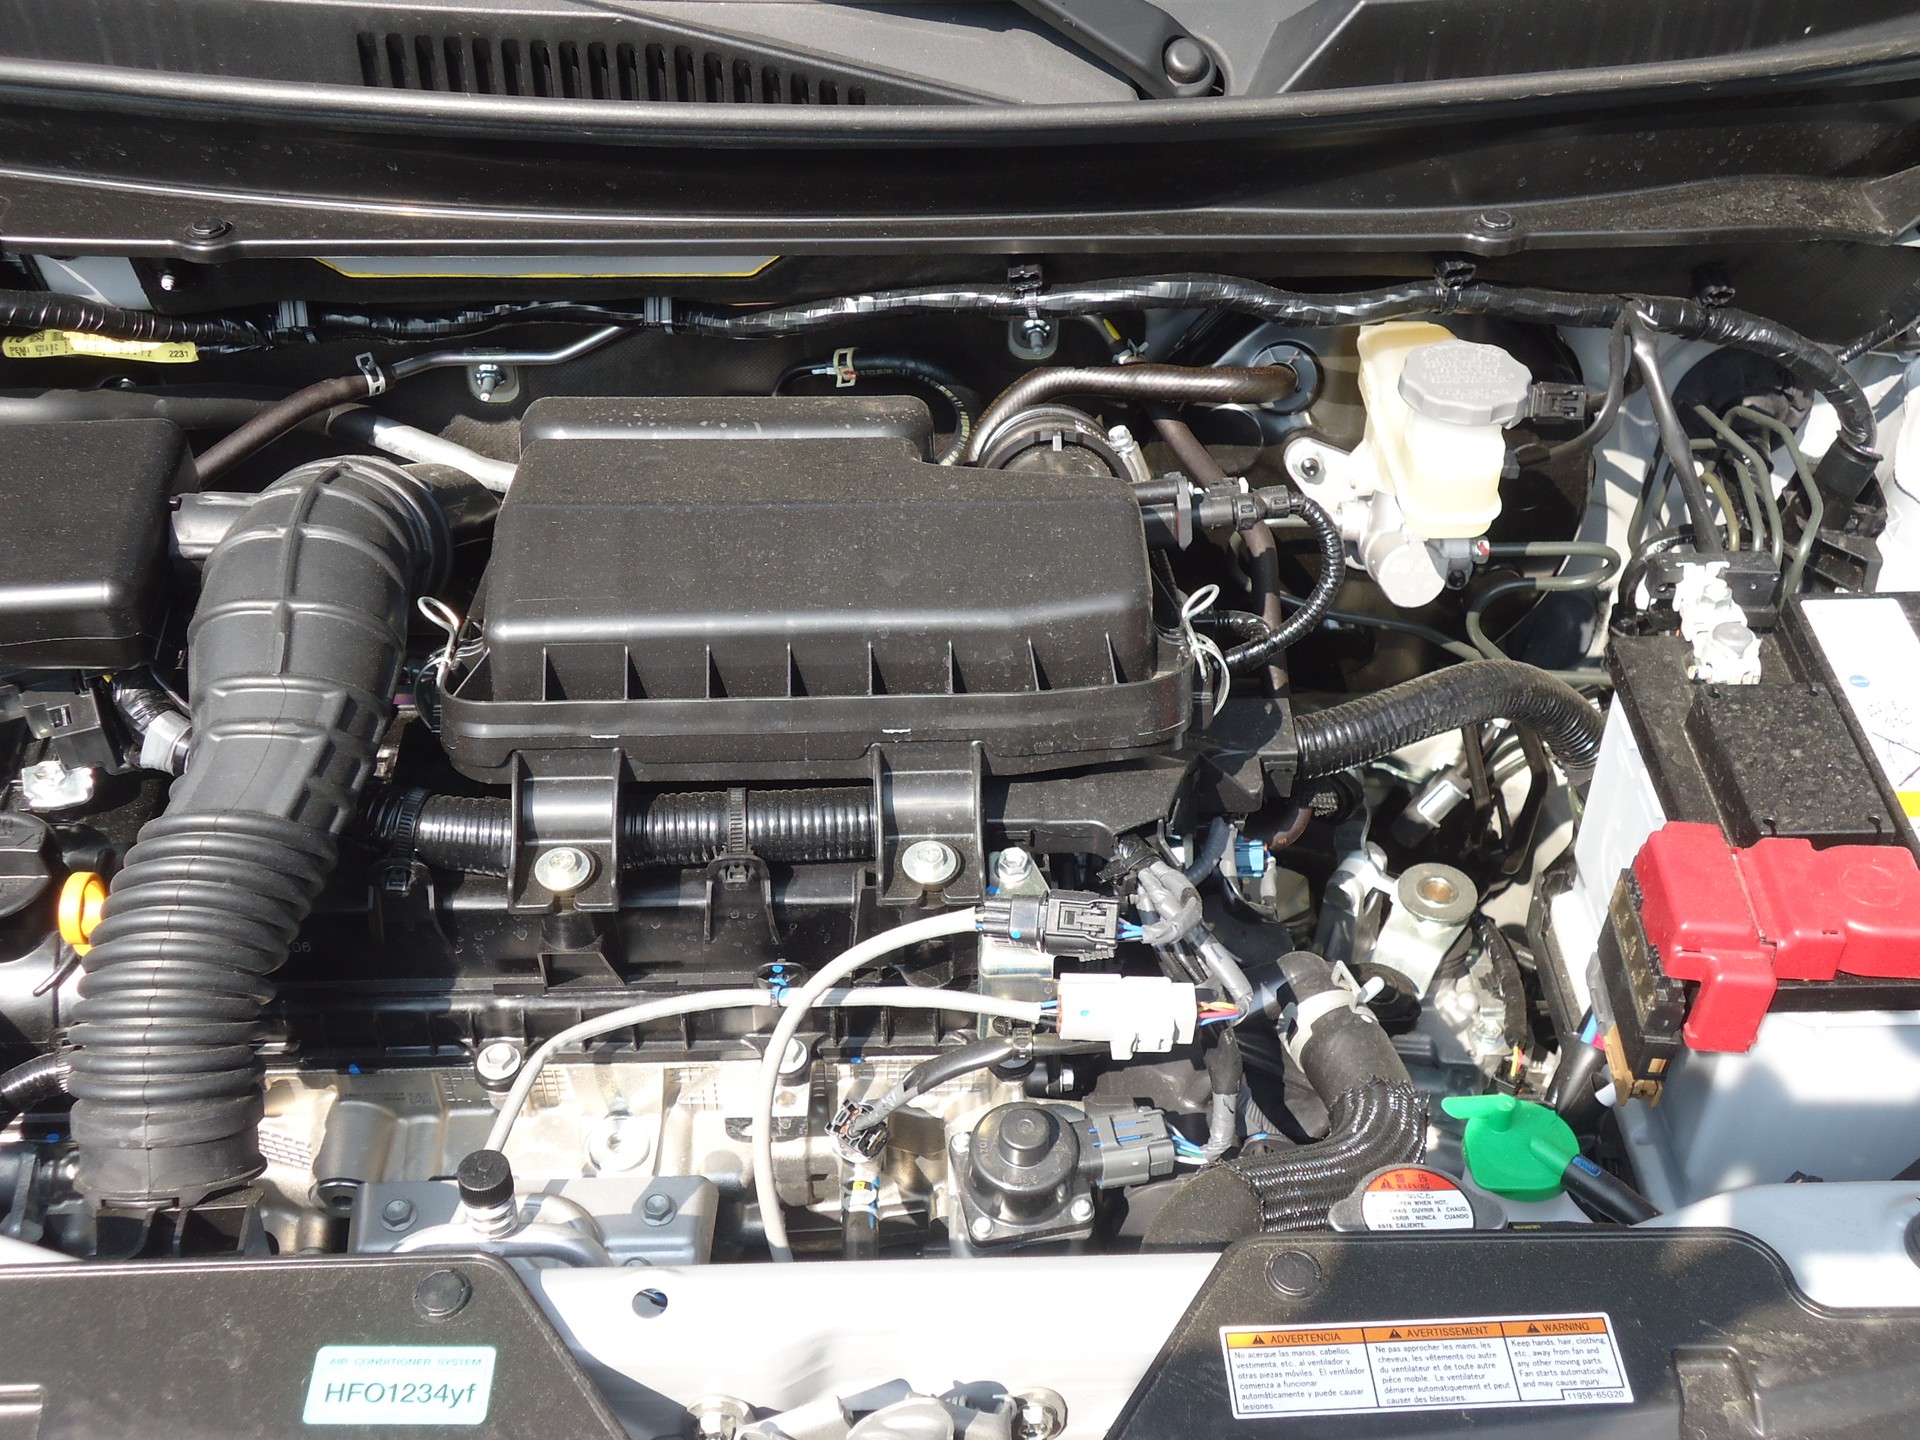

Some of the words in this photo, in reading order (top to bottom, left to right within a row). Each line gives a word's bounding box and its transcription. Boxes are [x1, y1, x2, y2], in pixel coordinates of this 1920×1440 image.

[169, 350, 188, 358] 2231
[1407, 1326, 1489, 1338] AVERTISSEMENT
[1542, 1322, 1590, 1332] WARNING
[1270, 1333, 1341, 1344] ADVERTENCIA
[1511, 1339, 1530, 1347] Keep
[1532, 1338, 1556, 1346] hands,
[1557, 1338, 1575, 1346] hair,
[1375, 1345, 1386, 1353] Ne
[1403, 1343, 1439, 1352] approcher
[1442, 1343, 1453, 1351] les
[1455, 1342, 1478, 1350] mains,
[1480, 1341, 1491, 1349] les
[1572, 1347, 1584, 1355] fan
[1247, 1351, 1276, 1359] acerque
[1319, 1348, 1352, 1356] cabellos,
[1378, 1355, 1410, 1363] cheveux,
[1412, 1354, 1423, 1362] les
[1425, 1352, 1464, 1361] vêtements
[354, 1358, 431, 1366] CONDITIONER
[438, 1358, 482, 1366] SYSTEM
[1236, 1361, 1278, 1369] vestimenta,
[1299, 1359, 1306, 1367] al
[1307, 1358, 1343, 1366] ventilador
[1532, 1359, 1551, 1367] other
[1554, 1358, 1581, 1366] moving
[1319, 1368, 1327, 1376] El
[1329, 1367, 1365, 1375] ventilador
[1380, 1366, 1389, 1374] du
[1391, 1364, 1430, 1373] ventilateur
[1443, 1363, 1453, 1371] de
[1536, 1369, 1558, 1377] starts
[1560, 1367, 1608, 1376] automatically
[1382, 1376, 1402, 1384] pièce
[1446, 1372, 1485, 1381] ventilateur
[1240, 1381, 1274, 1389] comienza
[1283, 1380, 1318, 1388] funcionar
[1384, 1386, 1415, 1394] démarre
[1417, 1383, 1481, 1393] automatiquement
[1493, 1382, 1510, 1390] peut
[1522, 1380, 1536, 1388] and
[324, 1383, 477, 1409] HFO1234yf
[1242, 1391, 1305, 1400] automáticamente
[1314, 1389, 1337, 1398] puede
[1414, 1395, 1427, 1403] des
[1567, 1391, 1624, 1399] 11958-65G20
